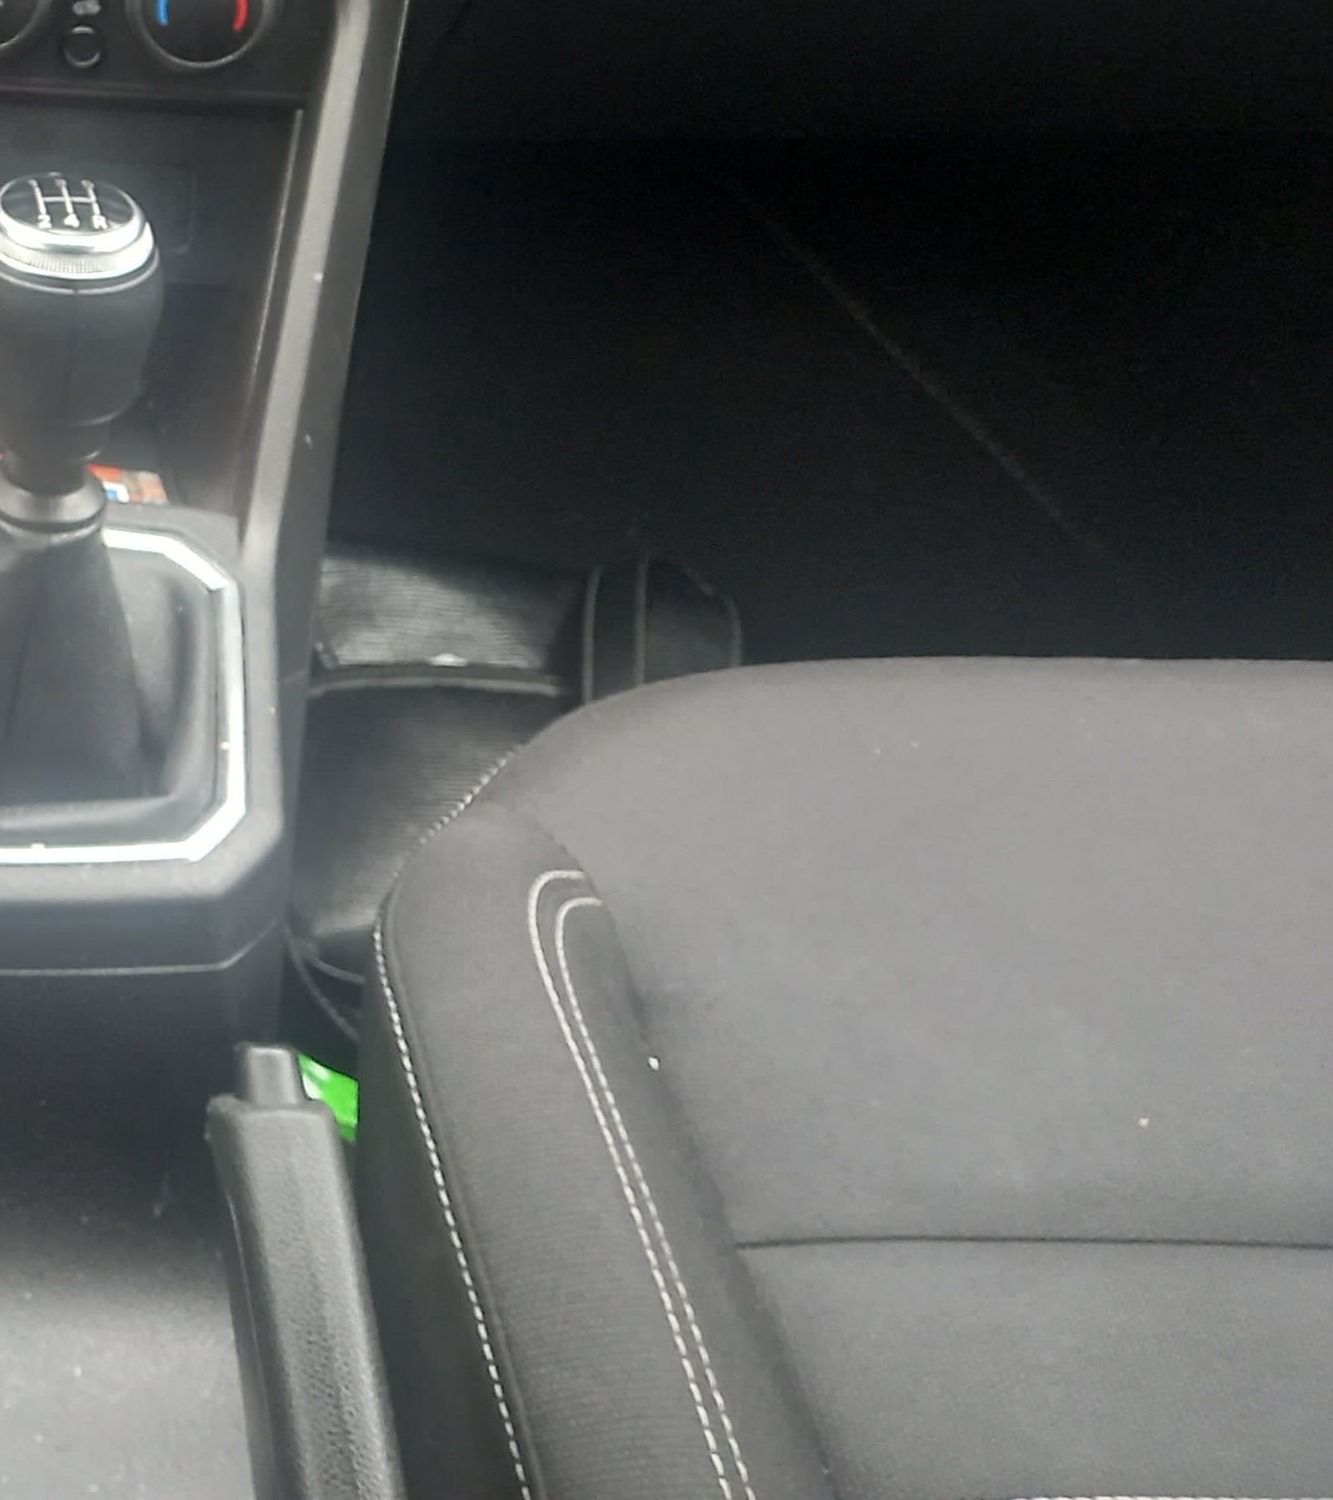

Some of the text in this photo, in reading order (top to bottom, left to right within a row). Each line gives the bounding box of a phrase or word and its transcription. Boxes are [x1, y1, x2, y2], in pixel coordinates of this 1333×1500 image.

[37, 214, 52, 229] 2
[63, 213, 80, 228] 4
[92, 215, 108, 229] R
